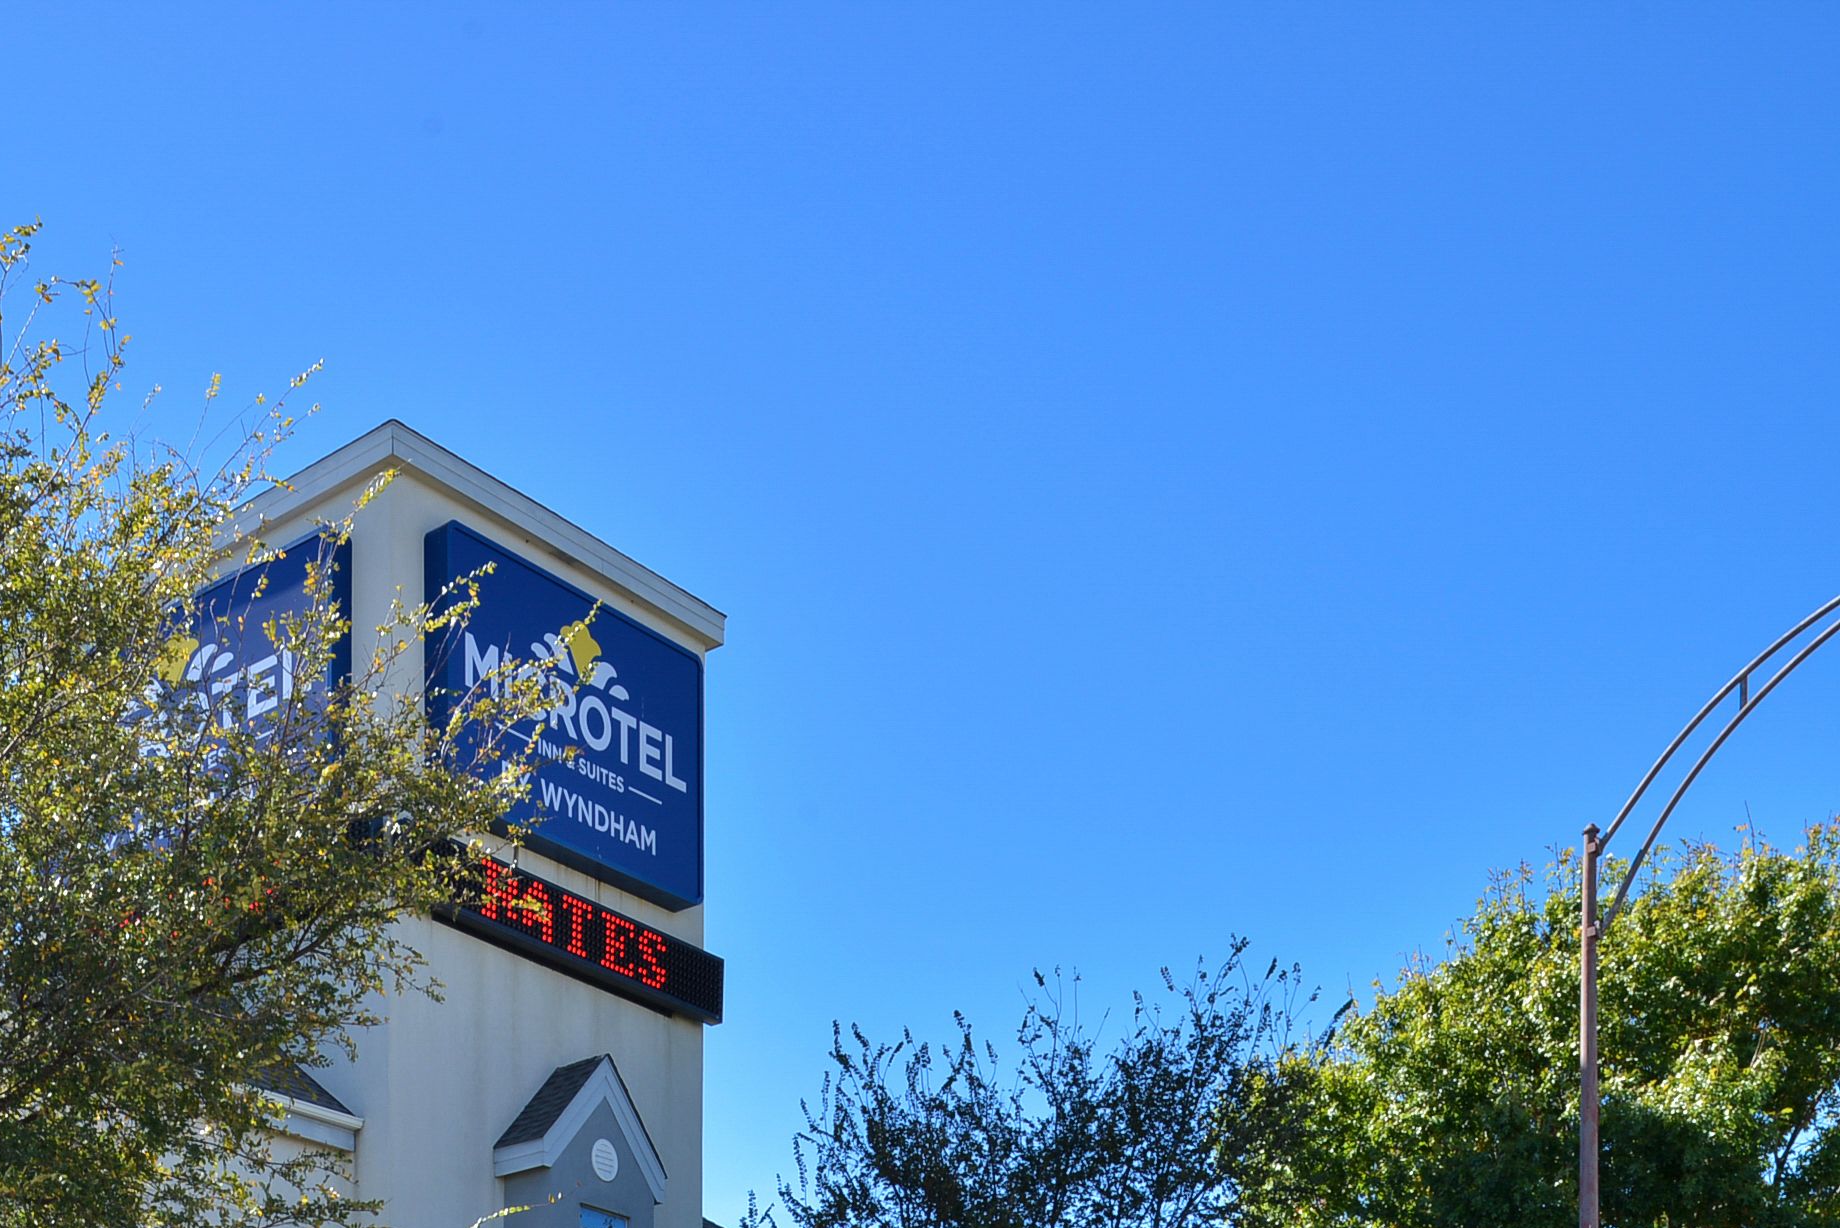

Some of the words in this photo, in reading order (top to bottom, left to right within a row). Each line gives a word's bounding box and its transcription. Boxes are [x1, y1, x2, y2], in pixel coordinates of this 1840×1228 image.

[537, 737, 562, 764] INN
[578, 757, 625, 793] SUITES
[541, 777, 656, 856] WYNDHAM
[481, 857, 666, 989] RATES
